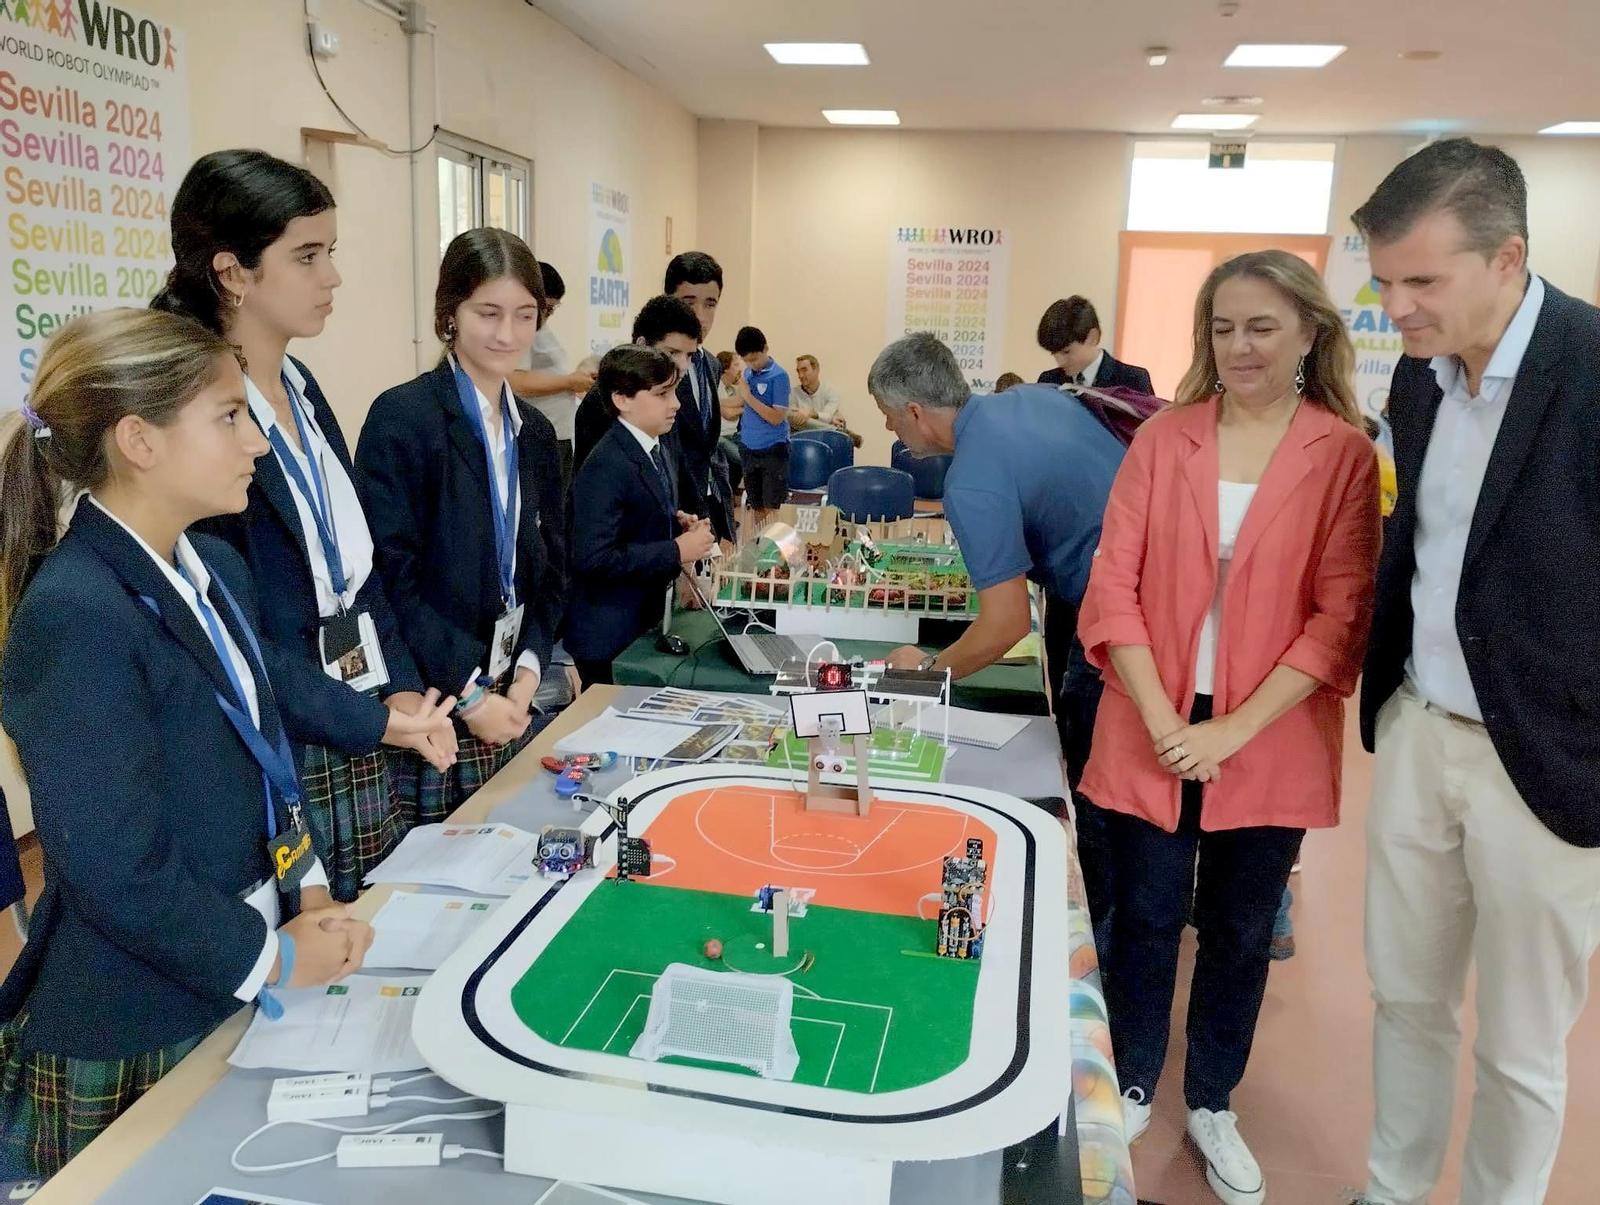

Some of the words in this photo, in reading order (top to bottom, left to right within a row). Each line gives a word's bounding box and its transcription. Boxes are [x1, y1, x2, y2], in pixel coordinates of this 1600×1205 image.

[78, 0, 161, 67] WRO
[47, 48, 90, 75] ROBOT
[0, 71, 97, 128] Sevilla
[105, 99, 162, 142] 2024
[1, 119, 99, 171] Sevilla
[108, 142, 164, 182] 2024
[4, 166, 102, 213] Sevilla
[111, 184, 168, 221] 2024
[8, 212, 105, 256] Sevilla
[113, 226, 170, 260] 2024
[949, 228, 994, 246] WRO
[907, 258, 953, 271] Sevilla
[957, 260, 989, 272] 2024
[12, 258, 107, 297] Sevilla
[906, 272, 952, 285] Sevilla
[956, 274, 989, 286] 2024
[590, 276, 629, 307] EARTH
[906, 286, 951, 299] Sevilla
[956, 288, 988, 300] 2024
[904, 314, 949, 327] Sevilla
[954, 316, 986, 328] 2024
[953, 331, 985, 342] 2024
[953, 344, 984, 356] 2024
[956, 358, 983, 370] 024
